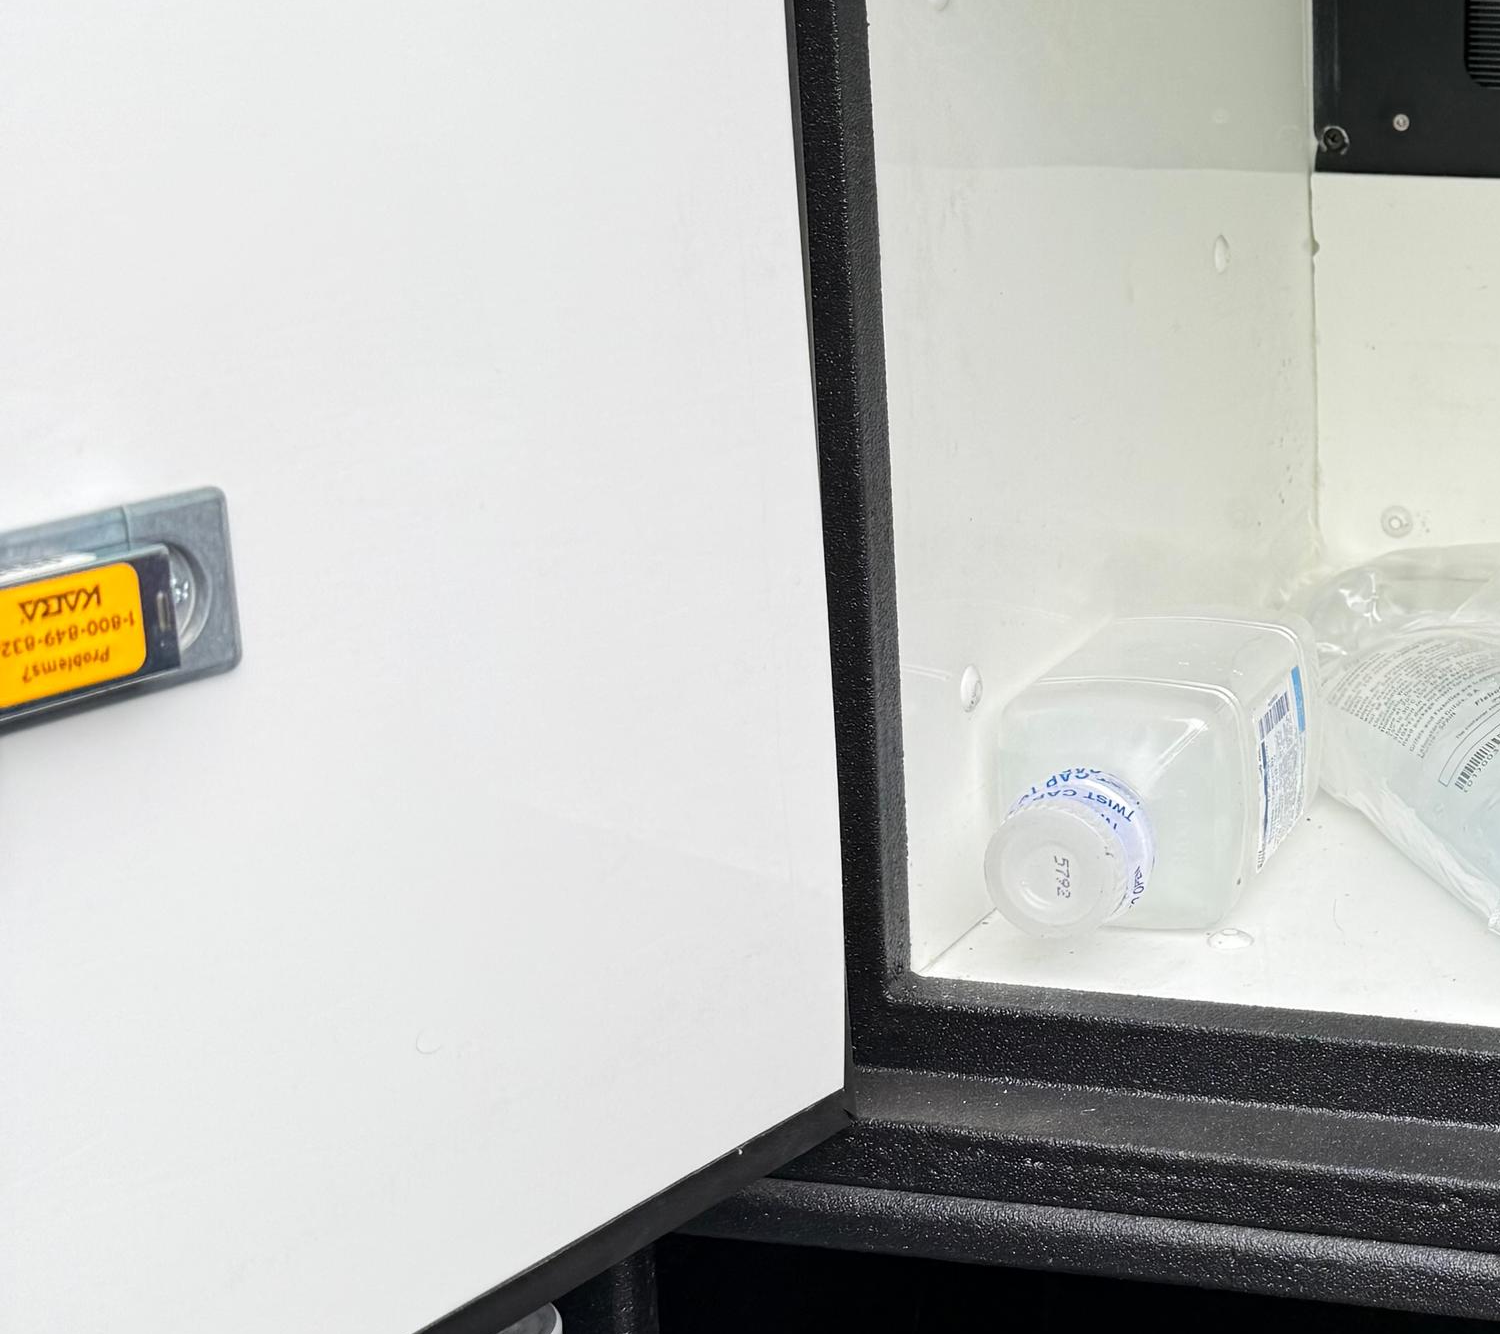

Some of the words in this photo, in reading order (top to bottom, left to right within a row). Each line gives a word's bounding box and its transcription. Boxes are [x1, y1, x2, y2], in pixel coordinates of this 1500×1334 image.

[18, 584, 102, 621] KABA
[0, 610, 136, 658] 1-800-849-832
[22, 645, 110, 684] Problems?
[1083, 791, 1136, 823] TWIST
